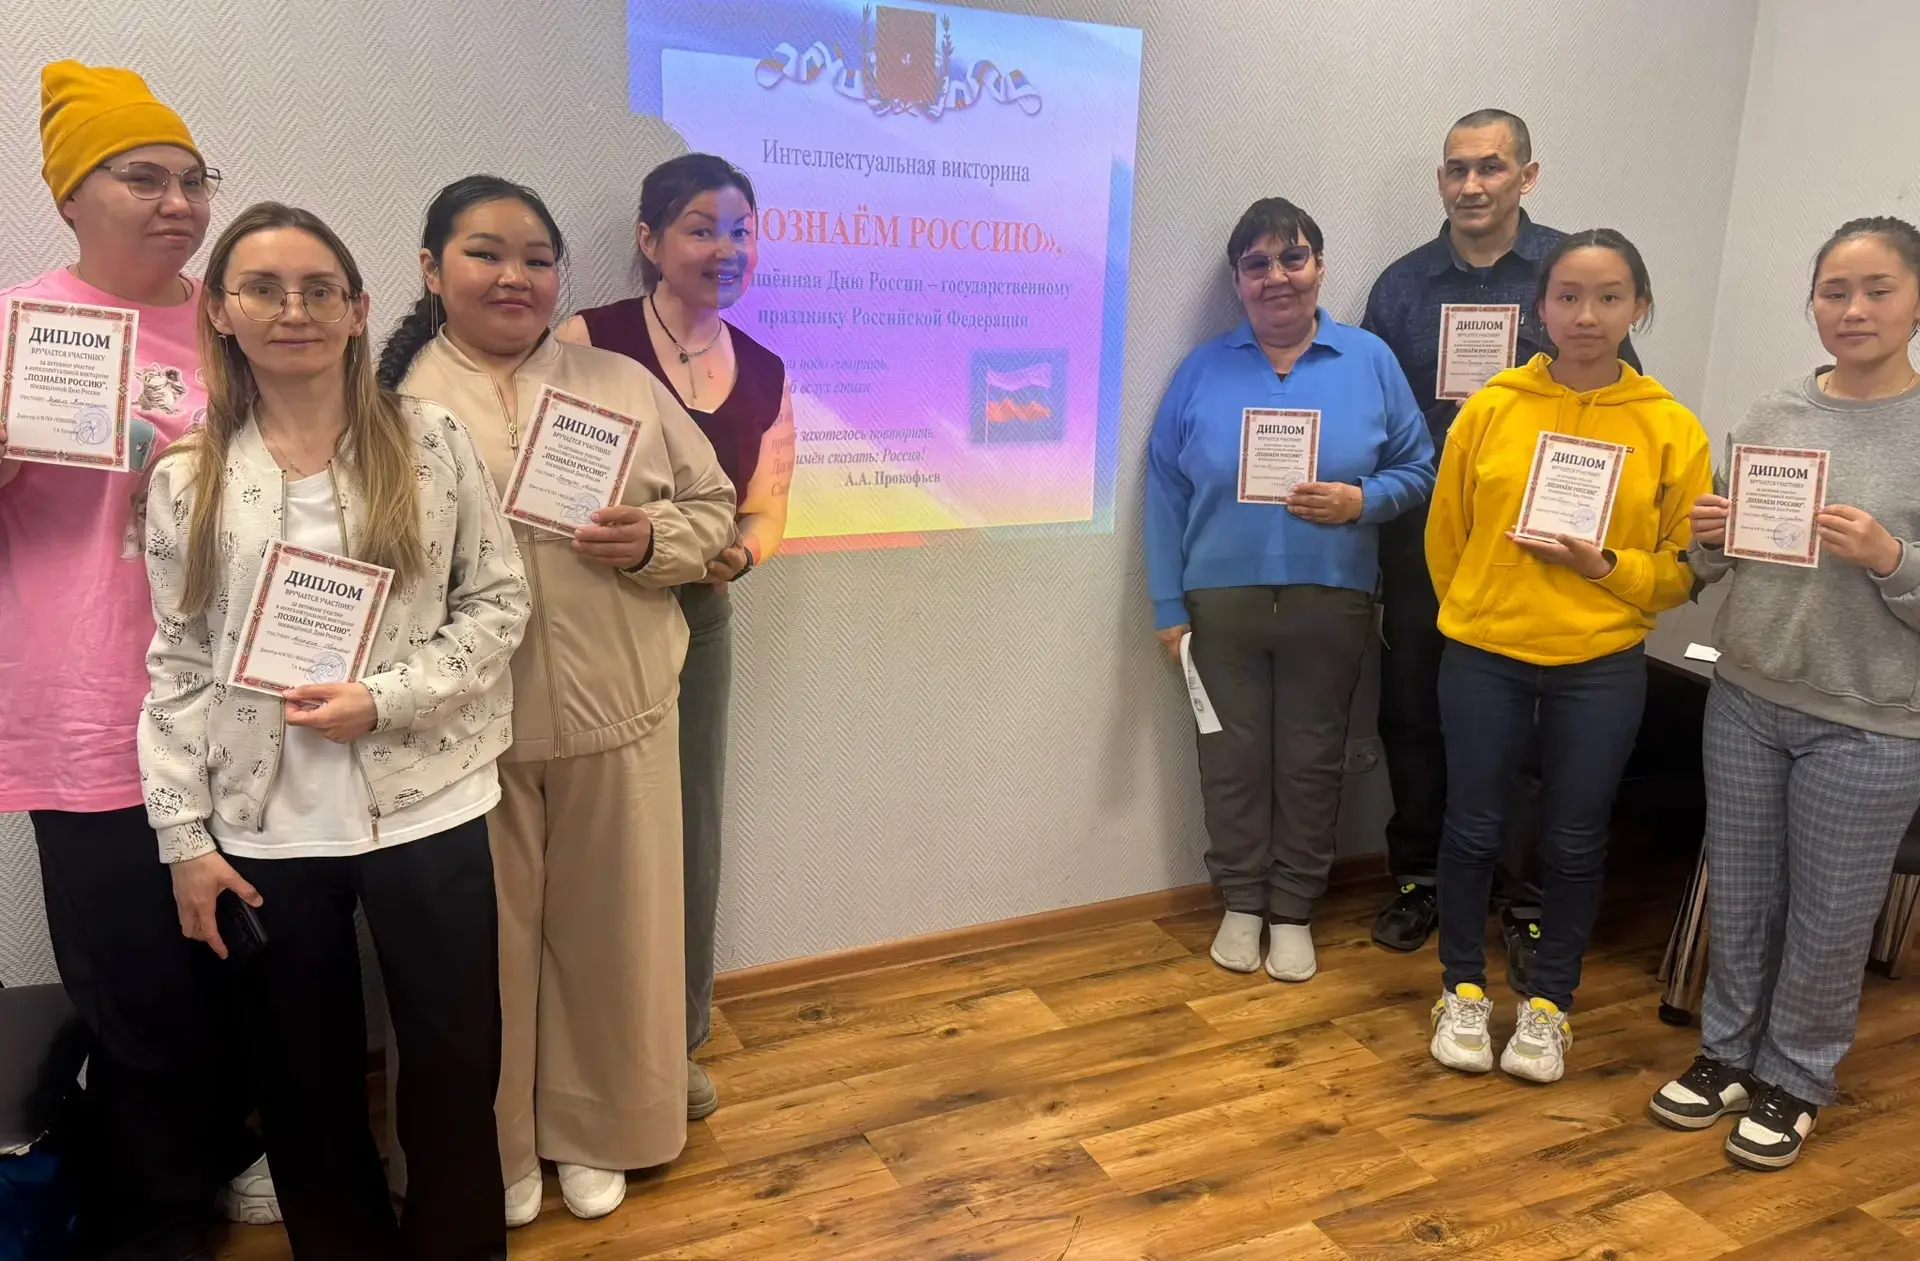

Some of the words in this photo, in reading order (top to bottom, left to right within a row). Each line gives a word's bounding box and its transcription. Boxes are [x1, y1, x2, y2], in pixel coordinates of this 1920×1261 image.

[761, 138, 936, 177] Интеллектуальная
[942, 159, 1030, 187] викторина
[756, 204, 901, 248] ОЗНАЁМ
[908, 216, 1063, 254] РОССИЮ».
[826, 269, 863, 293] Дню
[869, 272, 923, 292] России
[941, 279, 1072, 300] государственному
[758, 309, 846, 329] празднику
[852, 306, 943, 327] Российской
[946, 309, 1029, 332] Федерации
[1456, 320, 1503, 331] ДИПЛОМ
[29, 326, 111, 349] ДИПЛОМ
[31, 347, 67, 357] ВРУЧАЕТСЯ
[67, 352, 106, 361] УЧАСТНИКУ
[552, 414, 620, 448] ДИПЛОМ
[552, 431, 581, 445] ВРУЧАЕТСЯ
[800, 429, 866, 442] захотелось
[1256, 424, 1304, 435] ДИПЛОМ
[828, 452, 878, 465] сказать:
[881, 448, 927, 463] Россия!
[1551, 451, 1606, 470] ДИПЛОМ
[845, 474, 871, 486] А.А.
[875, 470, 941, 488] Прокофьев
[1748, 464, 1808, 479] ДИПЛОМ
[284, 570, 364, 601] ДИПЛОМ
[284, 588, 319, 602] ВРУЧАЕТСЯ
[320, 597, 356, 611] УЧАСТНИКУ
